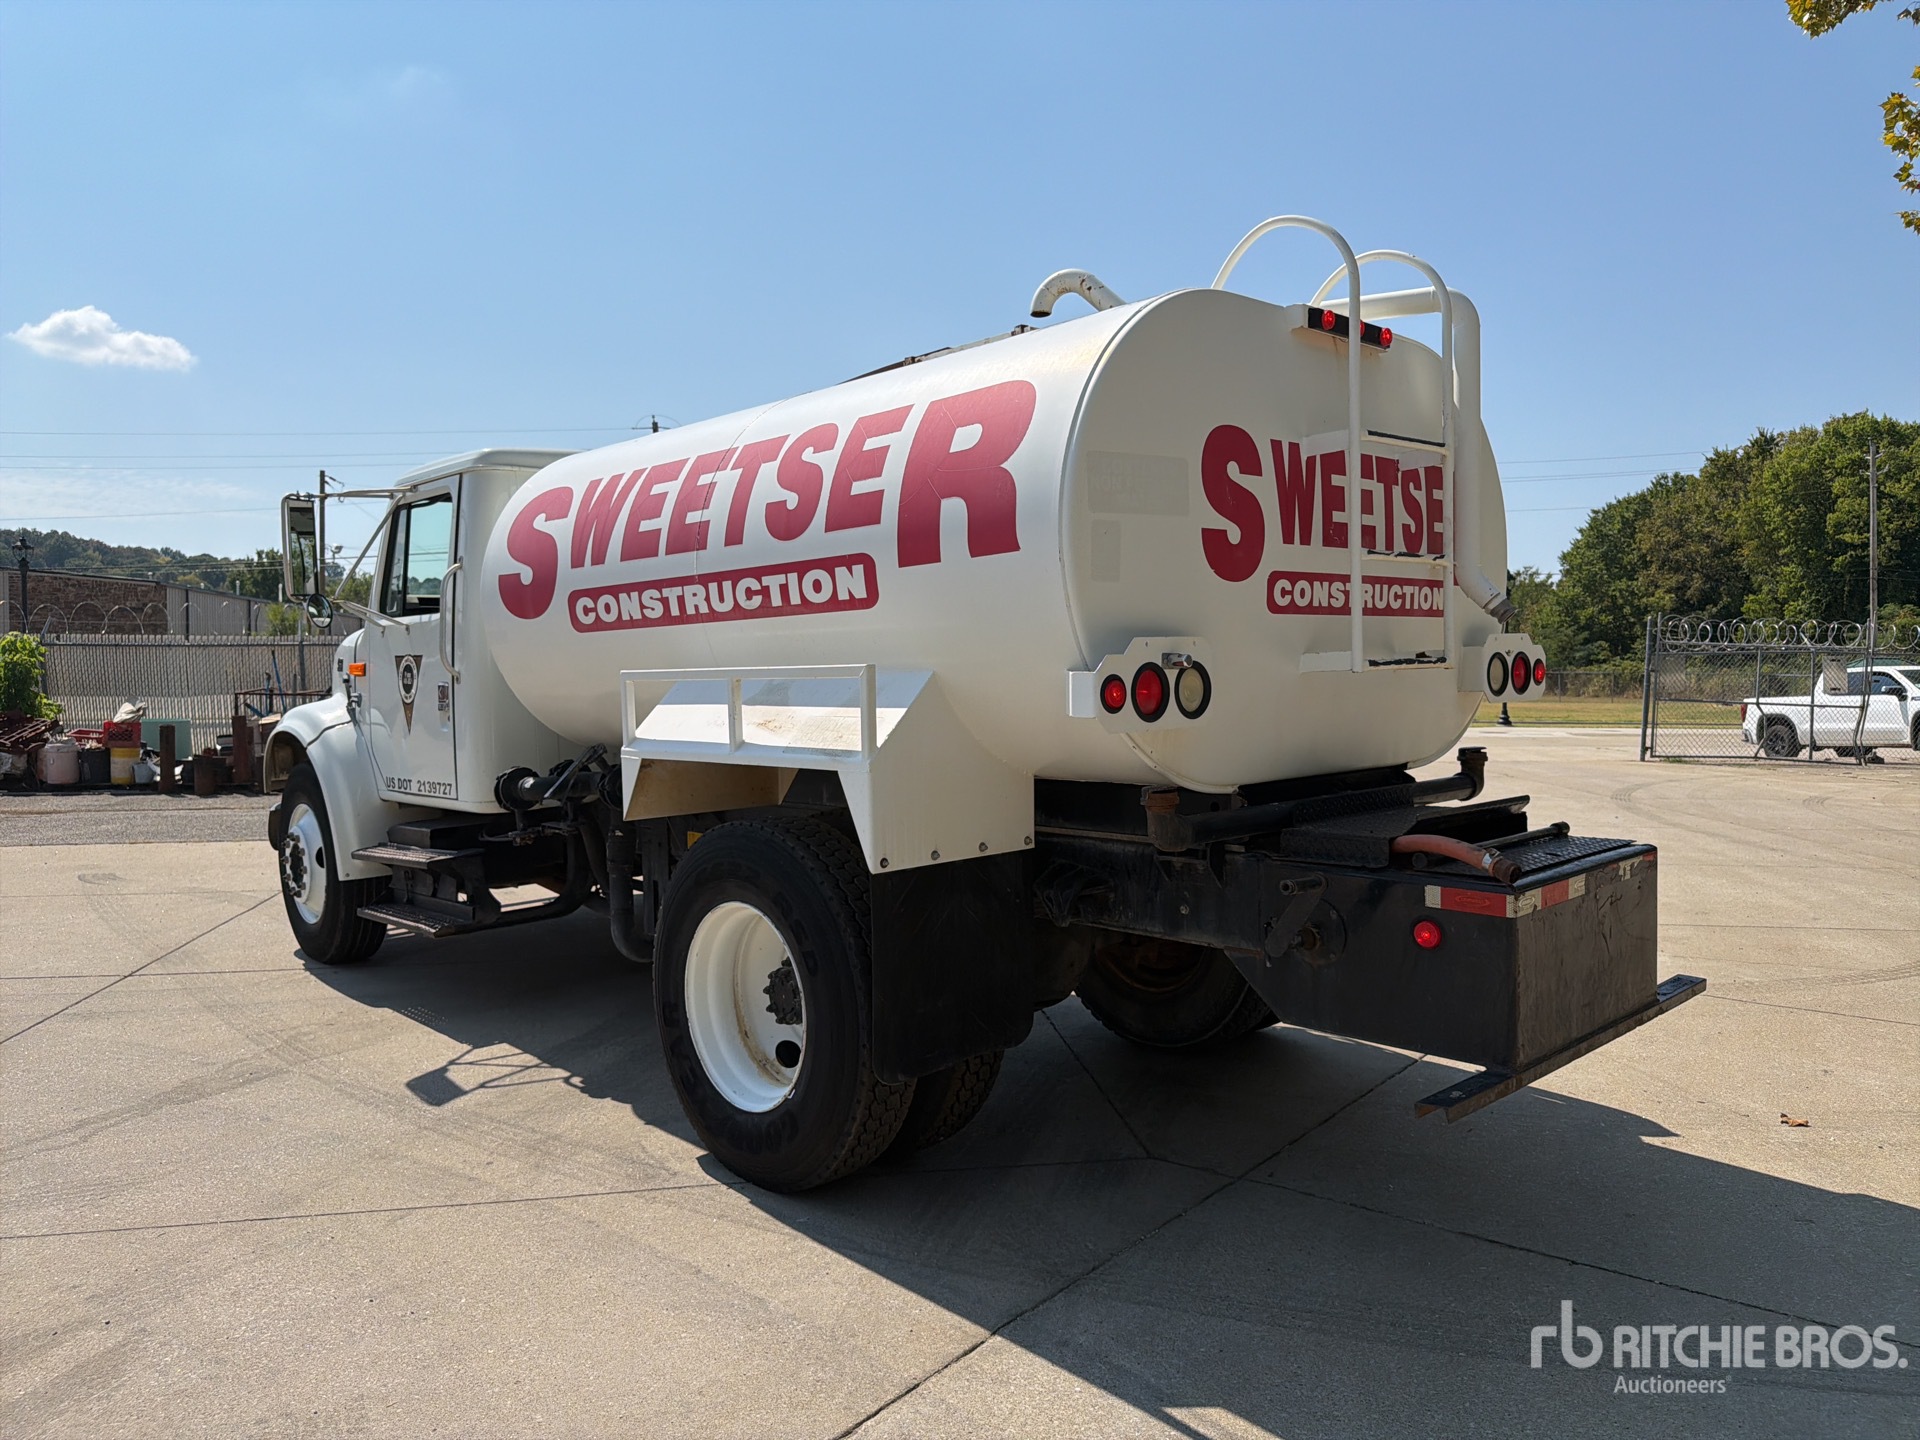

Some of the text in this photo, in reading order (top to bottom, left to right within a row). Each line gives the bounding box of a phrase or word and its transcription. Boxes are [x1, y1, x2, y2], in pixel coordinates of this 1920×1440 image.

[498, 380, 1036, 620] SWEETSER
[1201, 424, 1460, 586] SWEETSE
[575, 563, 868, 625] CONSTRUCTION
[386, 776, 453, 796] US DOT 2139727
